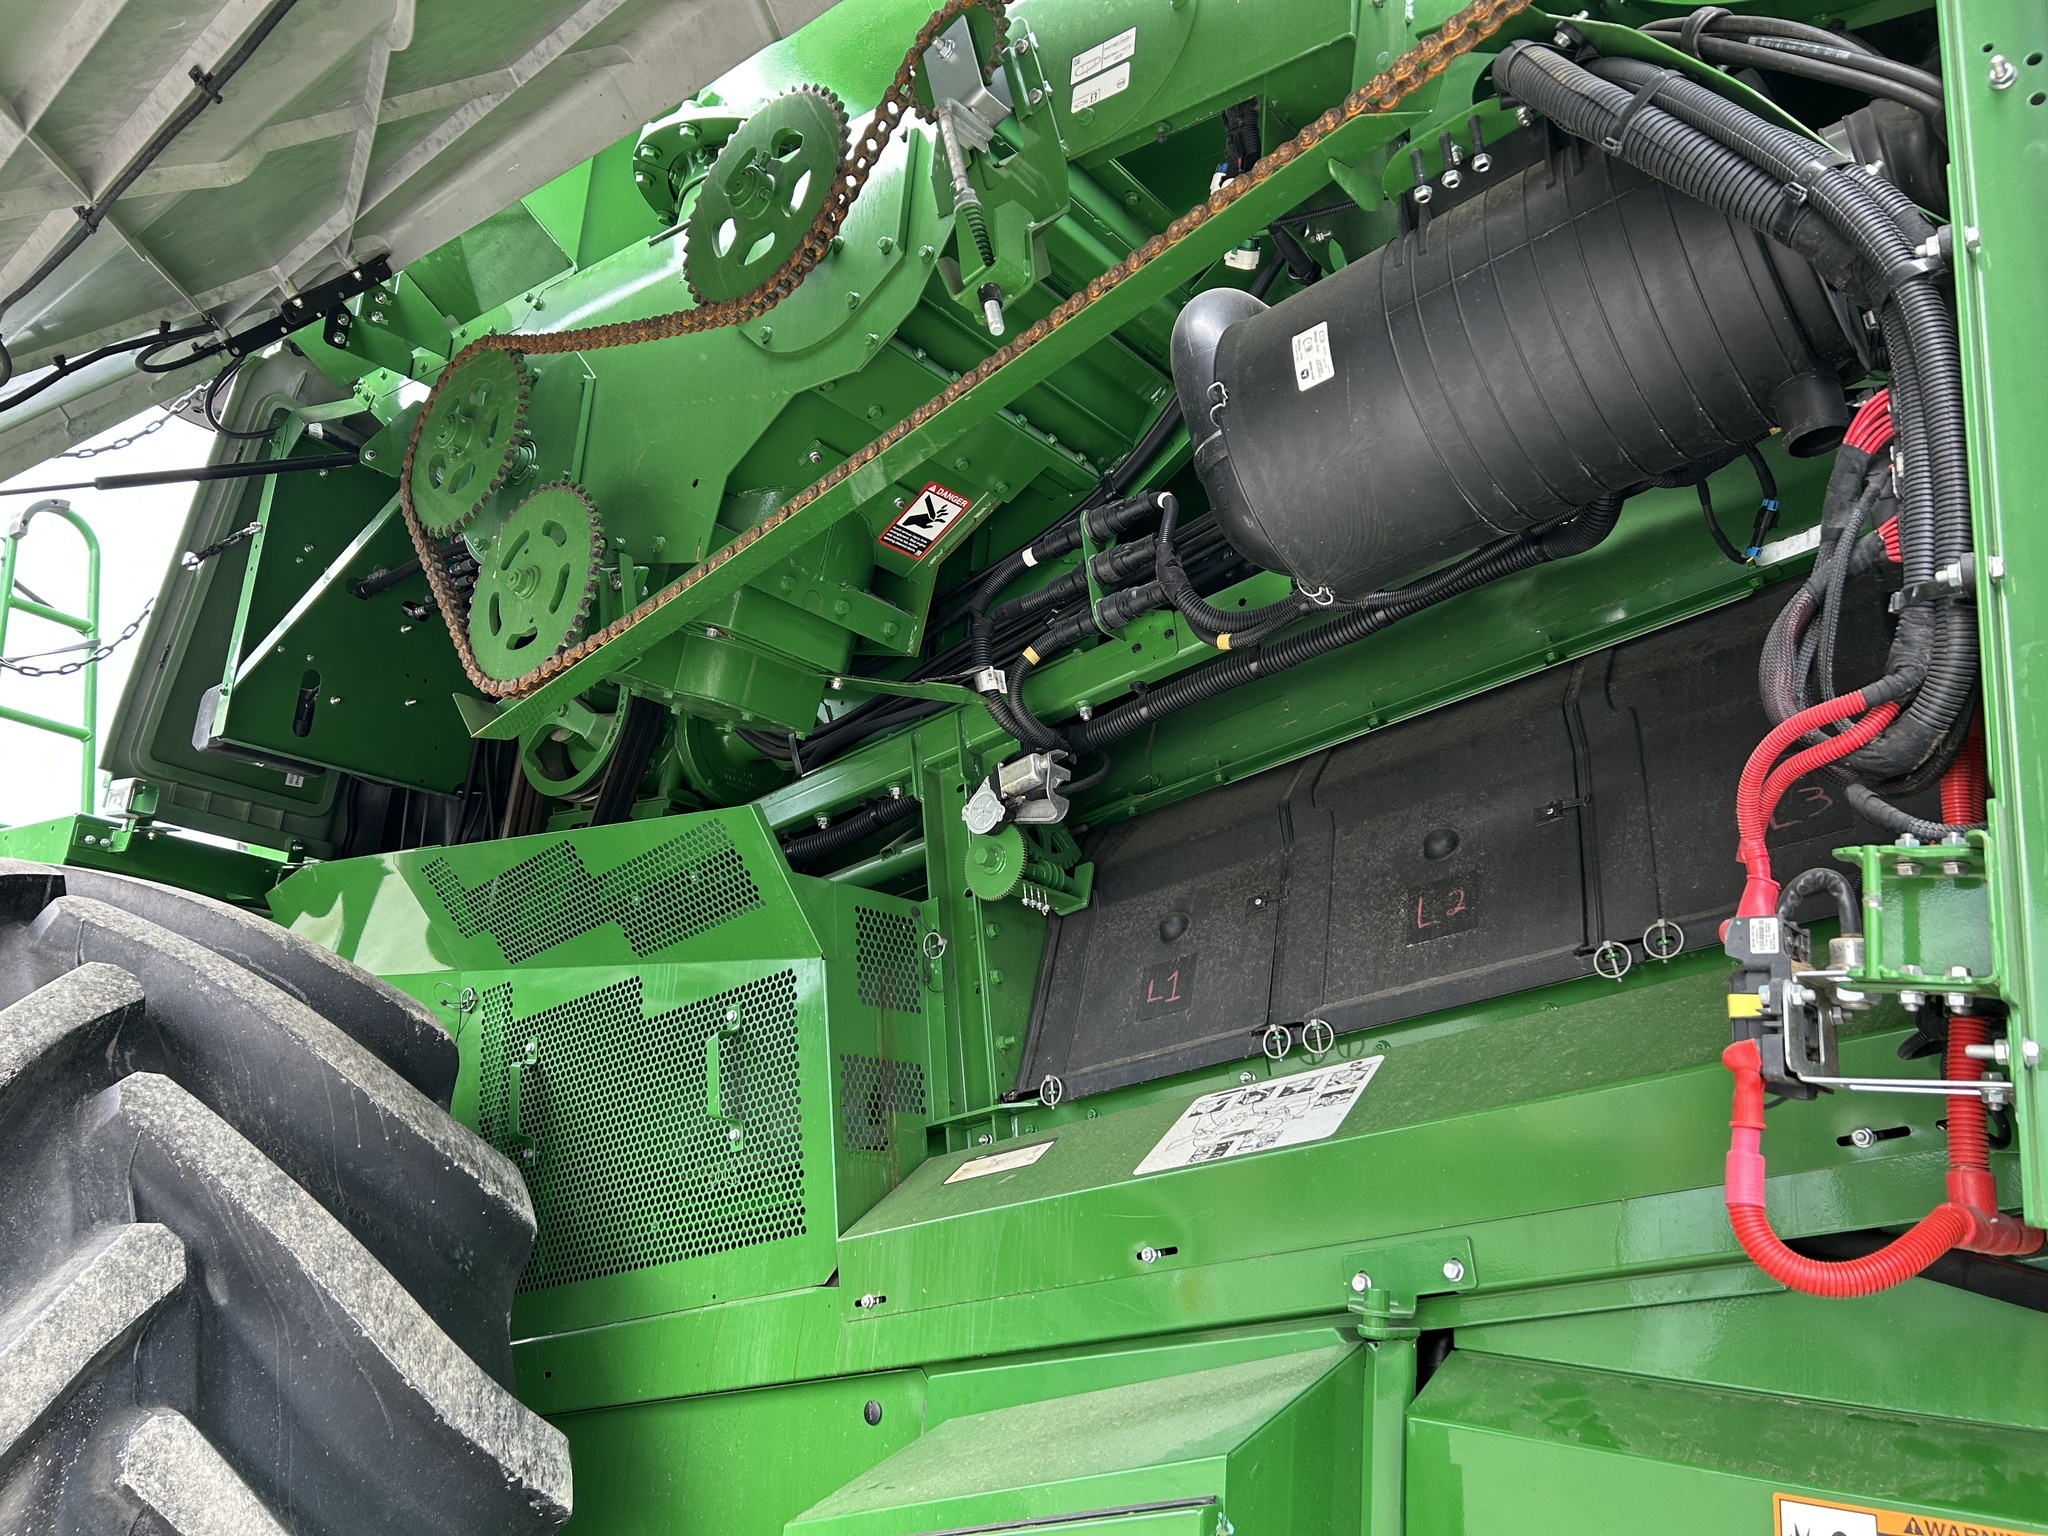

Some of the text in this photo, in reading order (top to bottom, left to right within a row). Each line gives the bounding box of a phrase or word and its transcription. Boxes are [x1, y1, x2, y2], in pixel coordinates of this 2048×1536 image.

[936, 488, 968, 508] DANGER
[1769, 786, 1834, 830] L3
[1417, 887, 1466, 929] L2
[1146, 969, 1181, 1004] L1
